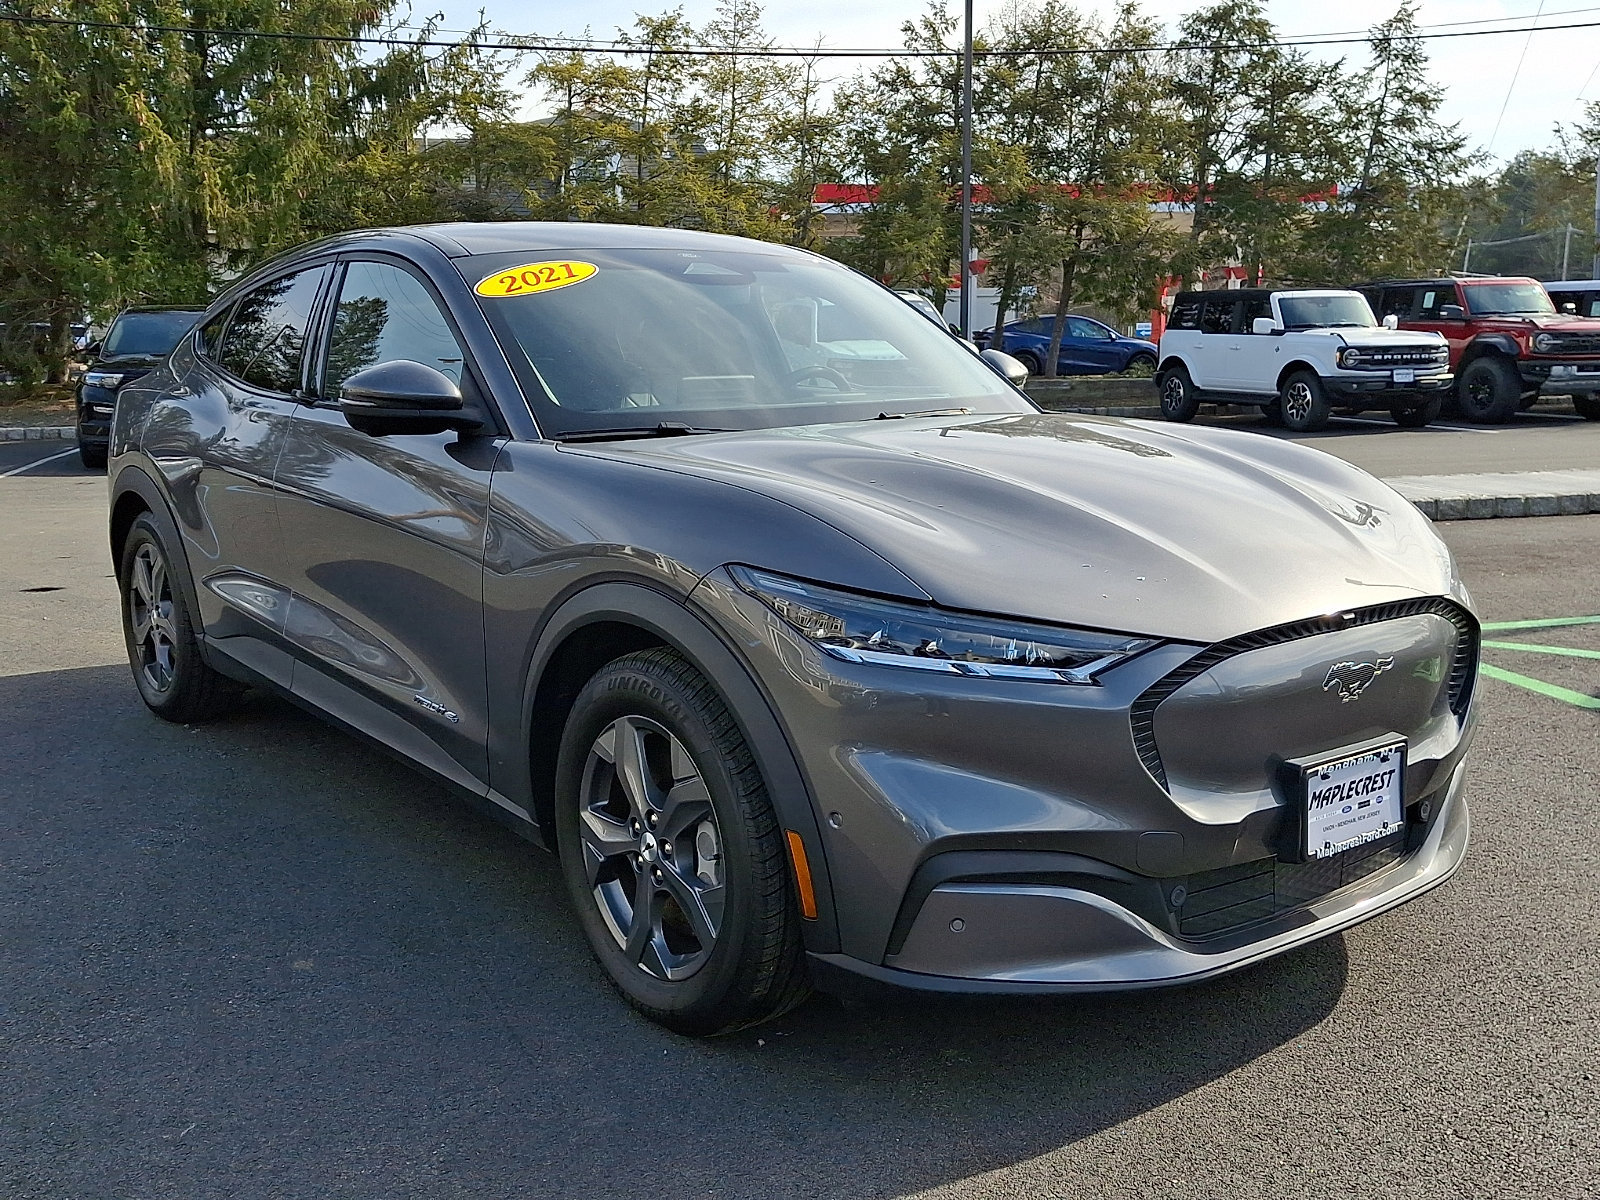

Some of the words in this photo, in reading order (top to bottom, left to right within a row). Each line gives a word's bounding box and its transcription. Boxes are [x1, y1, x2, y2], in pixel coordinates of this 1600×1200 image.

[499, 263, 579, 293] 2021
[607, 675, 687, 720] UNIROYAL
[1308, 769, 1396, 811] MAPLECREST
[1357, 814, 1366, 822] NEW
[1315, 824, 1399, 860] MaplecrestFord.com
